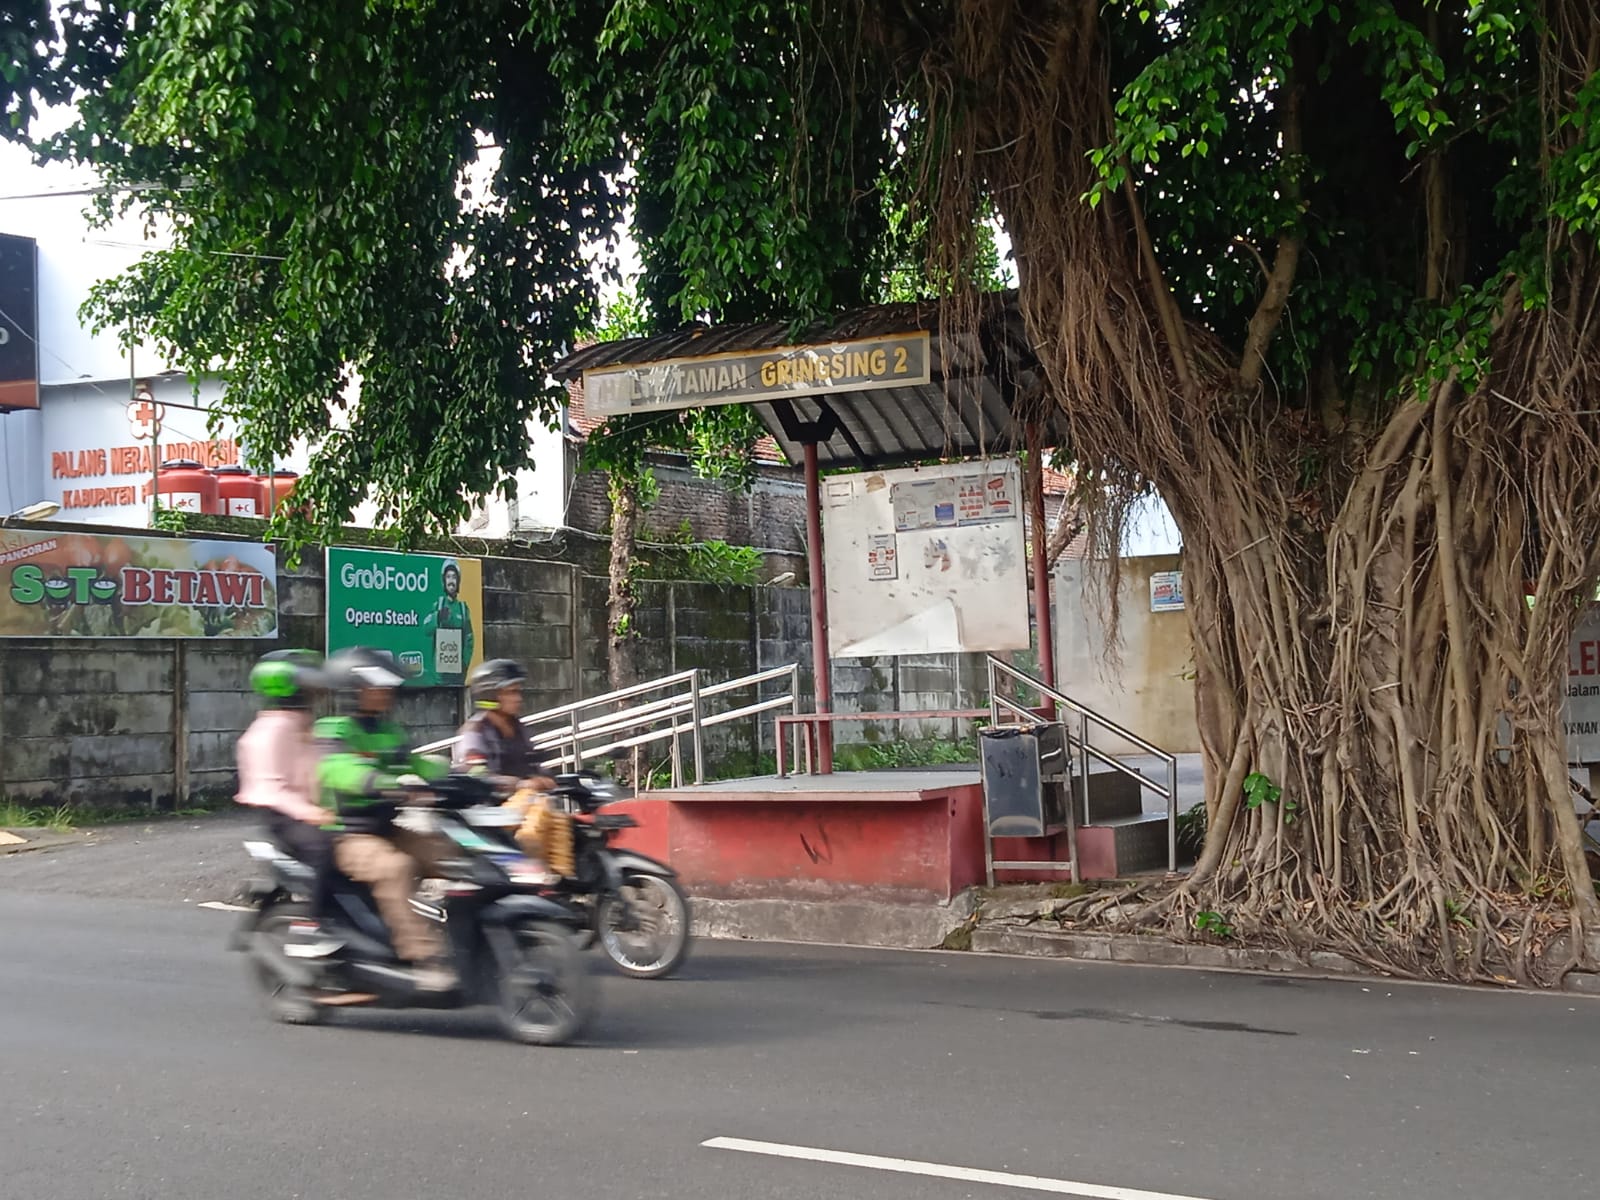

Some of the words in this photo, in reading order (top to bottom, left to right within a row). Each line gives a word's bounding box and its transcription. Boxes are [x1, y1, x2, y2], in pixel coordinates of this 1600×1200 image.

[673, 364, 747, 395] TAMAN
[761, 348, 887, 387] GRINGSING
[894, 346, 908, 374] 2
[52, 448, 107, 479] PALANG
[63, 485, 136, 510] KABUPATEN
[122, 568, 265, 607] BETAWI
[341, 562, 428, 592] GrabFood
[345, 607, 383, 627] Opera
[385, 609, 418, 626] Steak
[440, 640, 458, 651] Grab
[440, 652, 459, 664] Food
[1567, 640, 1600, 677] LE
